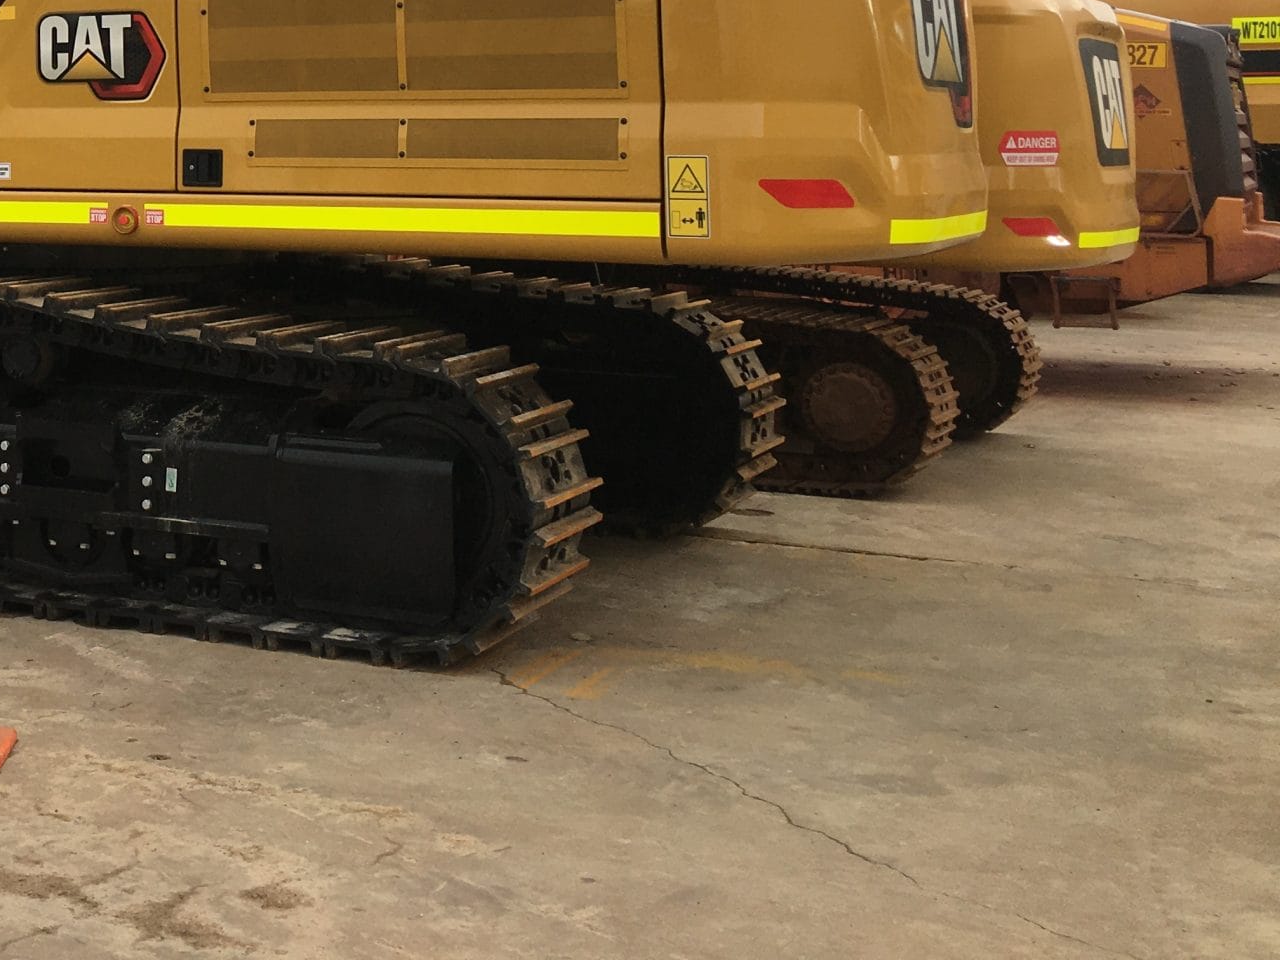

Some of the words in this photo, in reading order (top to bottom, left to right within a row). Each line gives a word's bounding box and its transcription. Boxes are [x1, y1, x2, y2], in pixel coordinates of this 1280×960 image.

[39, 14, 131, 81] CAT
[1092, 55, 1128, 149] CAT
[1017, 136, 1057, 149] DANGER
[90, 213, 107, 223] STOP
[146, 215, 163, 225] STOP
